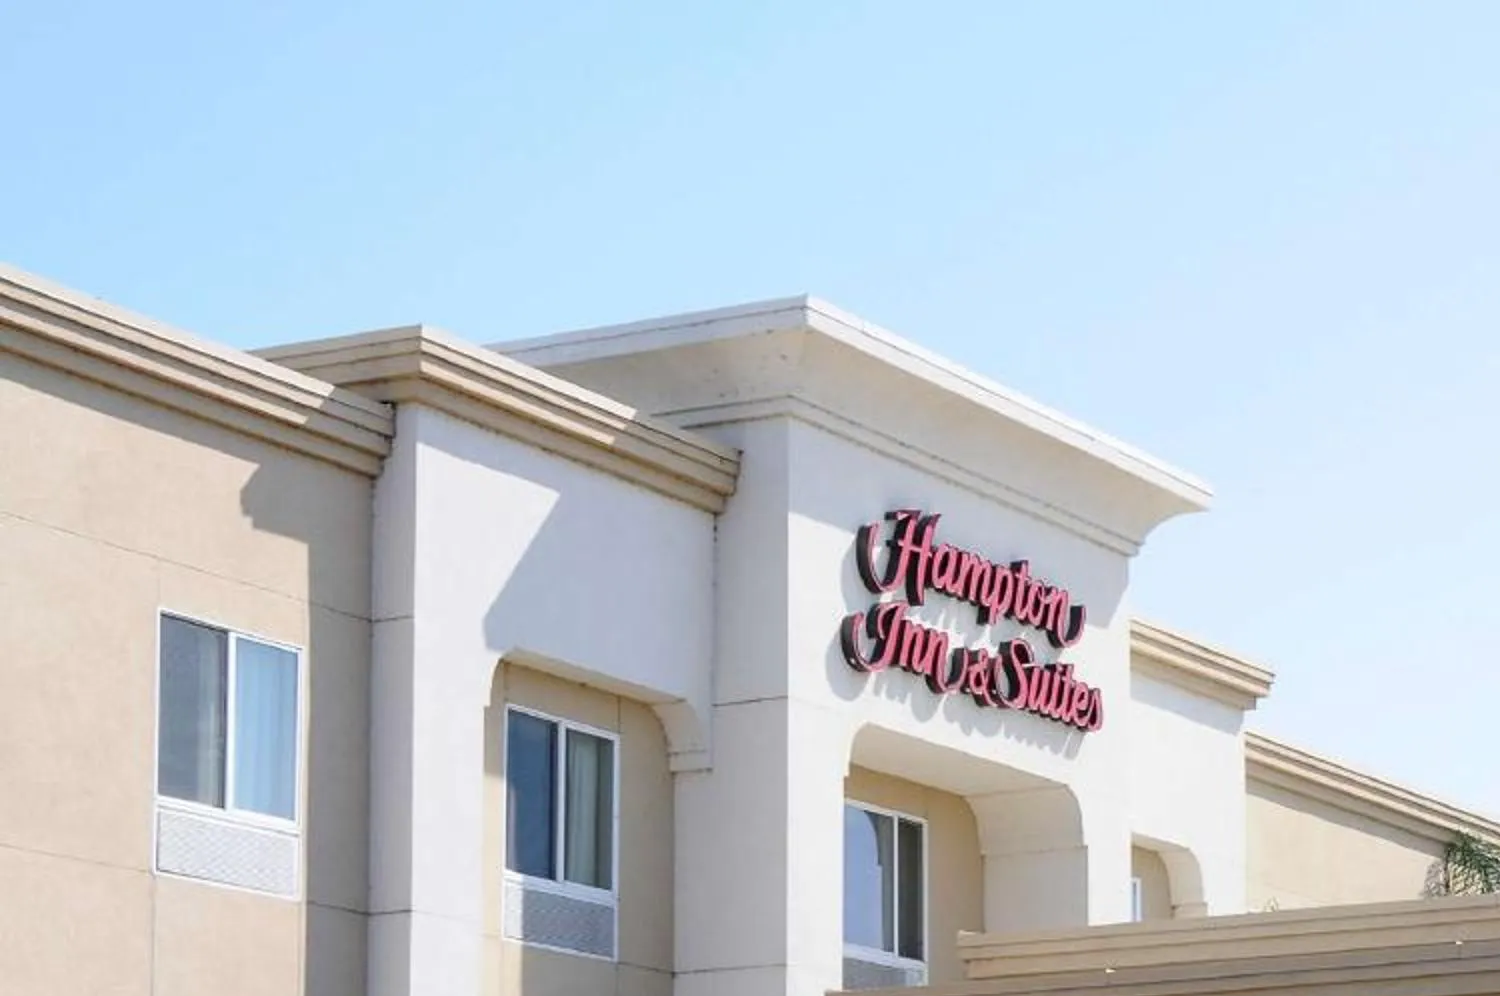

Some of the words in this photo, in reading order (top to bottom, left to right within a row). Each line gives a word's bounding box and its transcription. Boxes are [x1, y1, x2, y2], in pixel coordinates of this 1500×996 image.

[856, 509, 1086, 648] Hampton
[841, 599, 969, 693] Inn
[966, 648, 997, 708] &
[993, 637, 1104, 732] Suites
